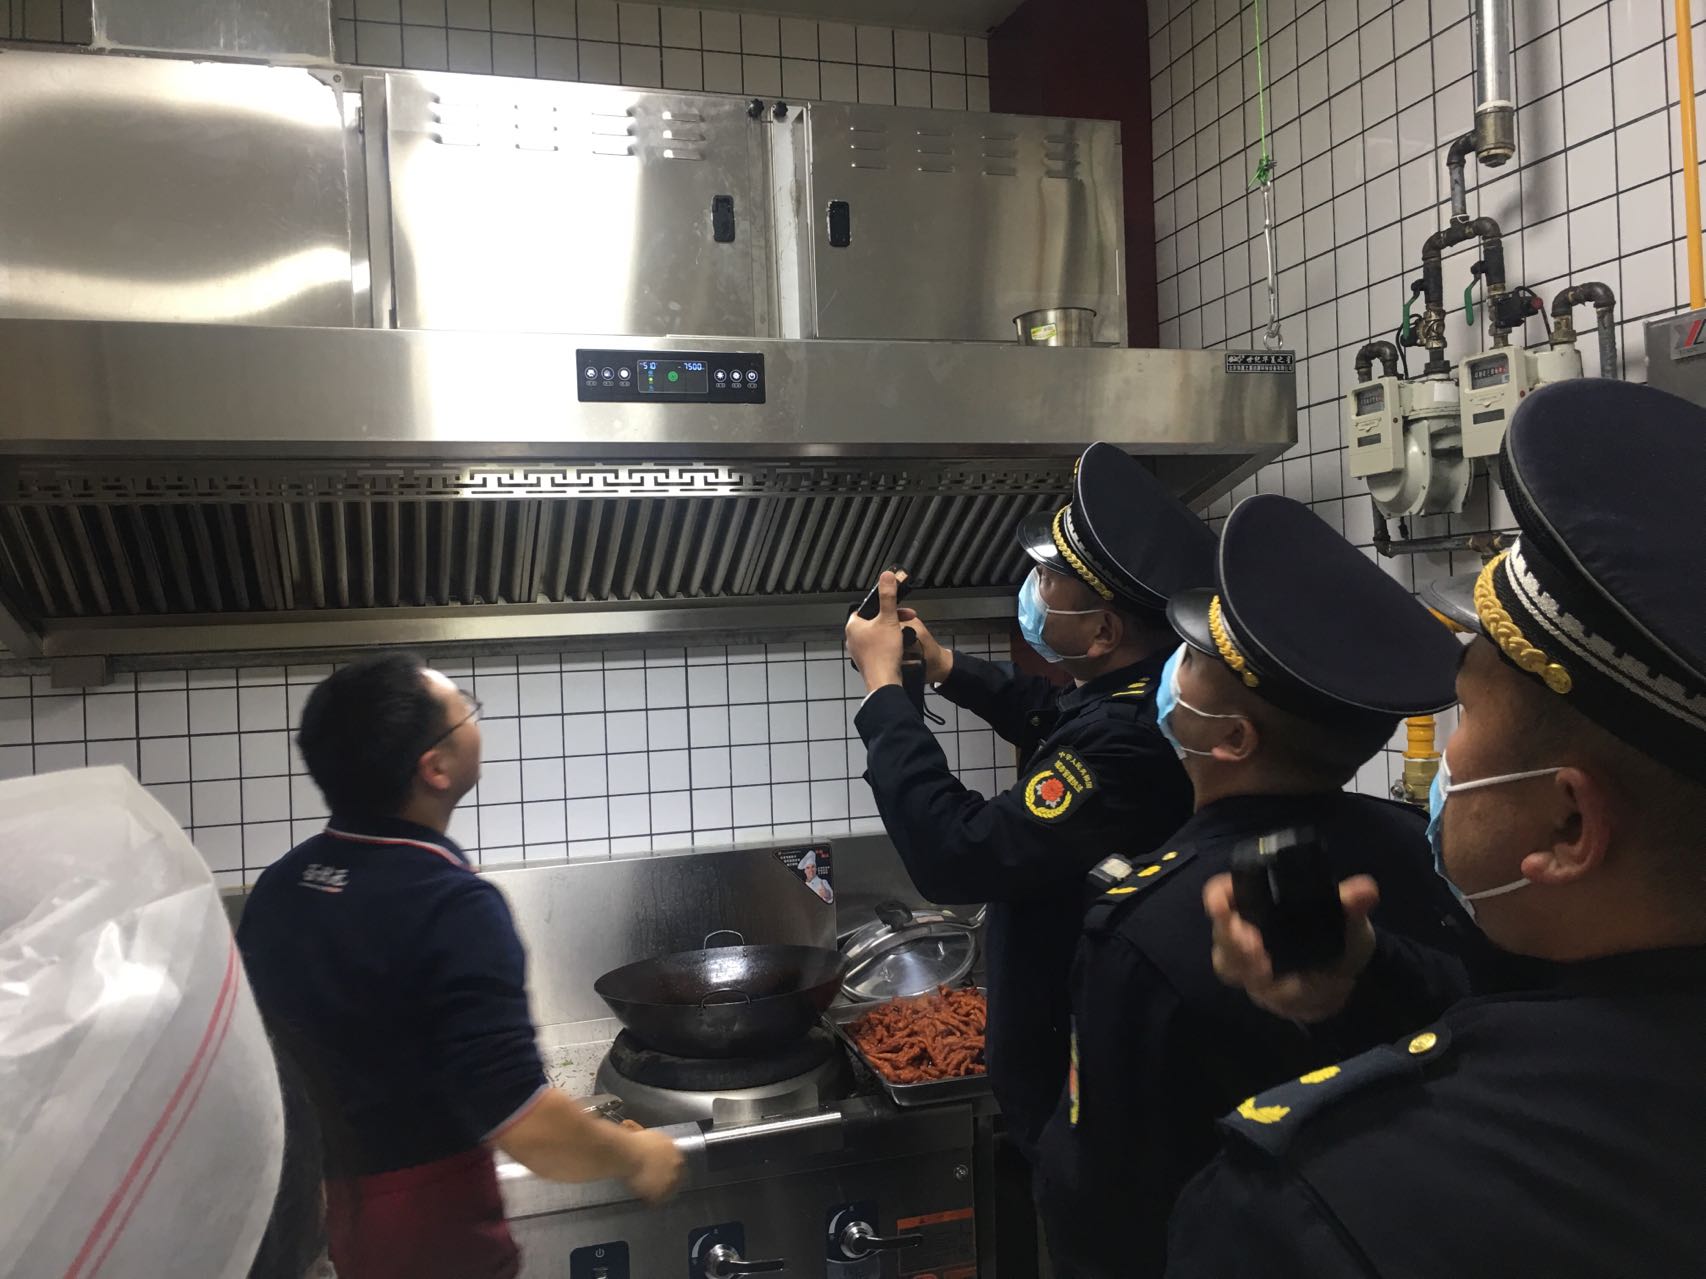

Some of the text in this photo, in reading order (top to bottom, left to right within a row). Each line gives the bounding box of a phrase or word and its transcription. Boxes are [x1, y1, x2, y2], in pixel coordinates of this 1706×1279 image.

[683, 362, 702, 371] 7500
[1058, 751, 1093, 789] 中华人民共和国
